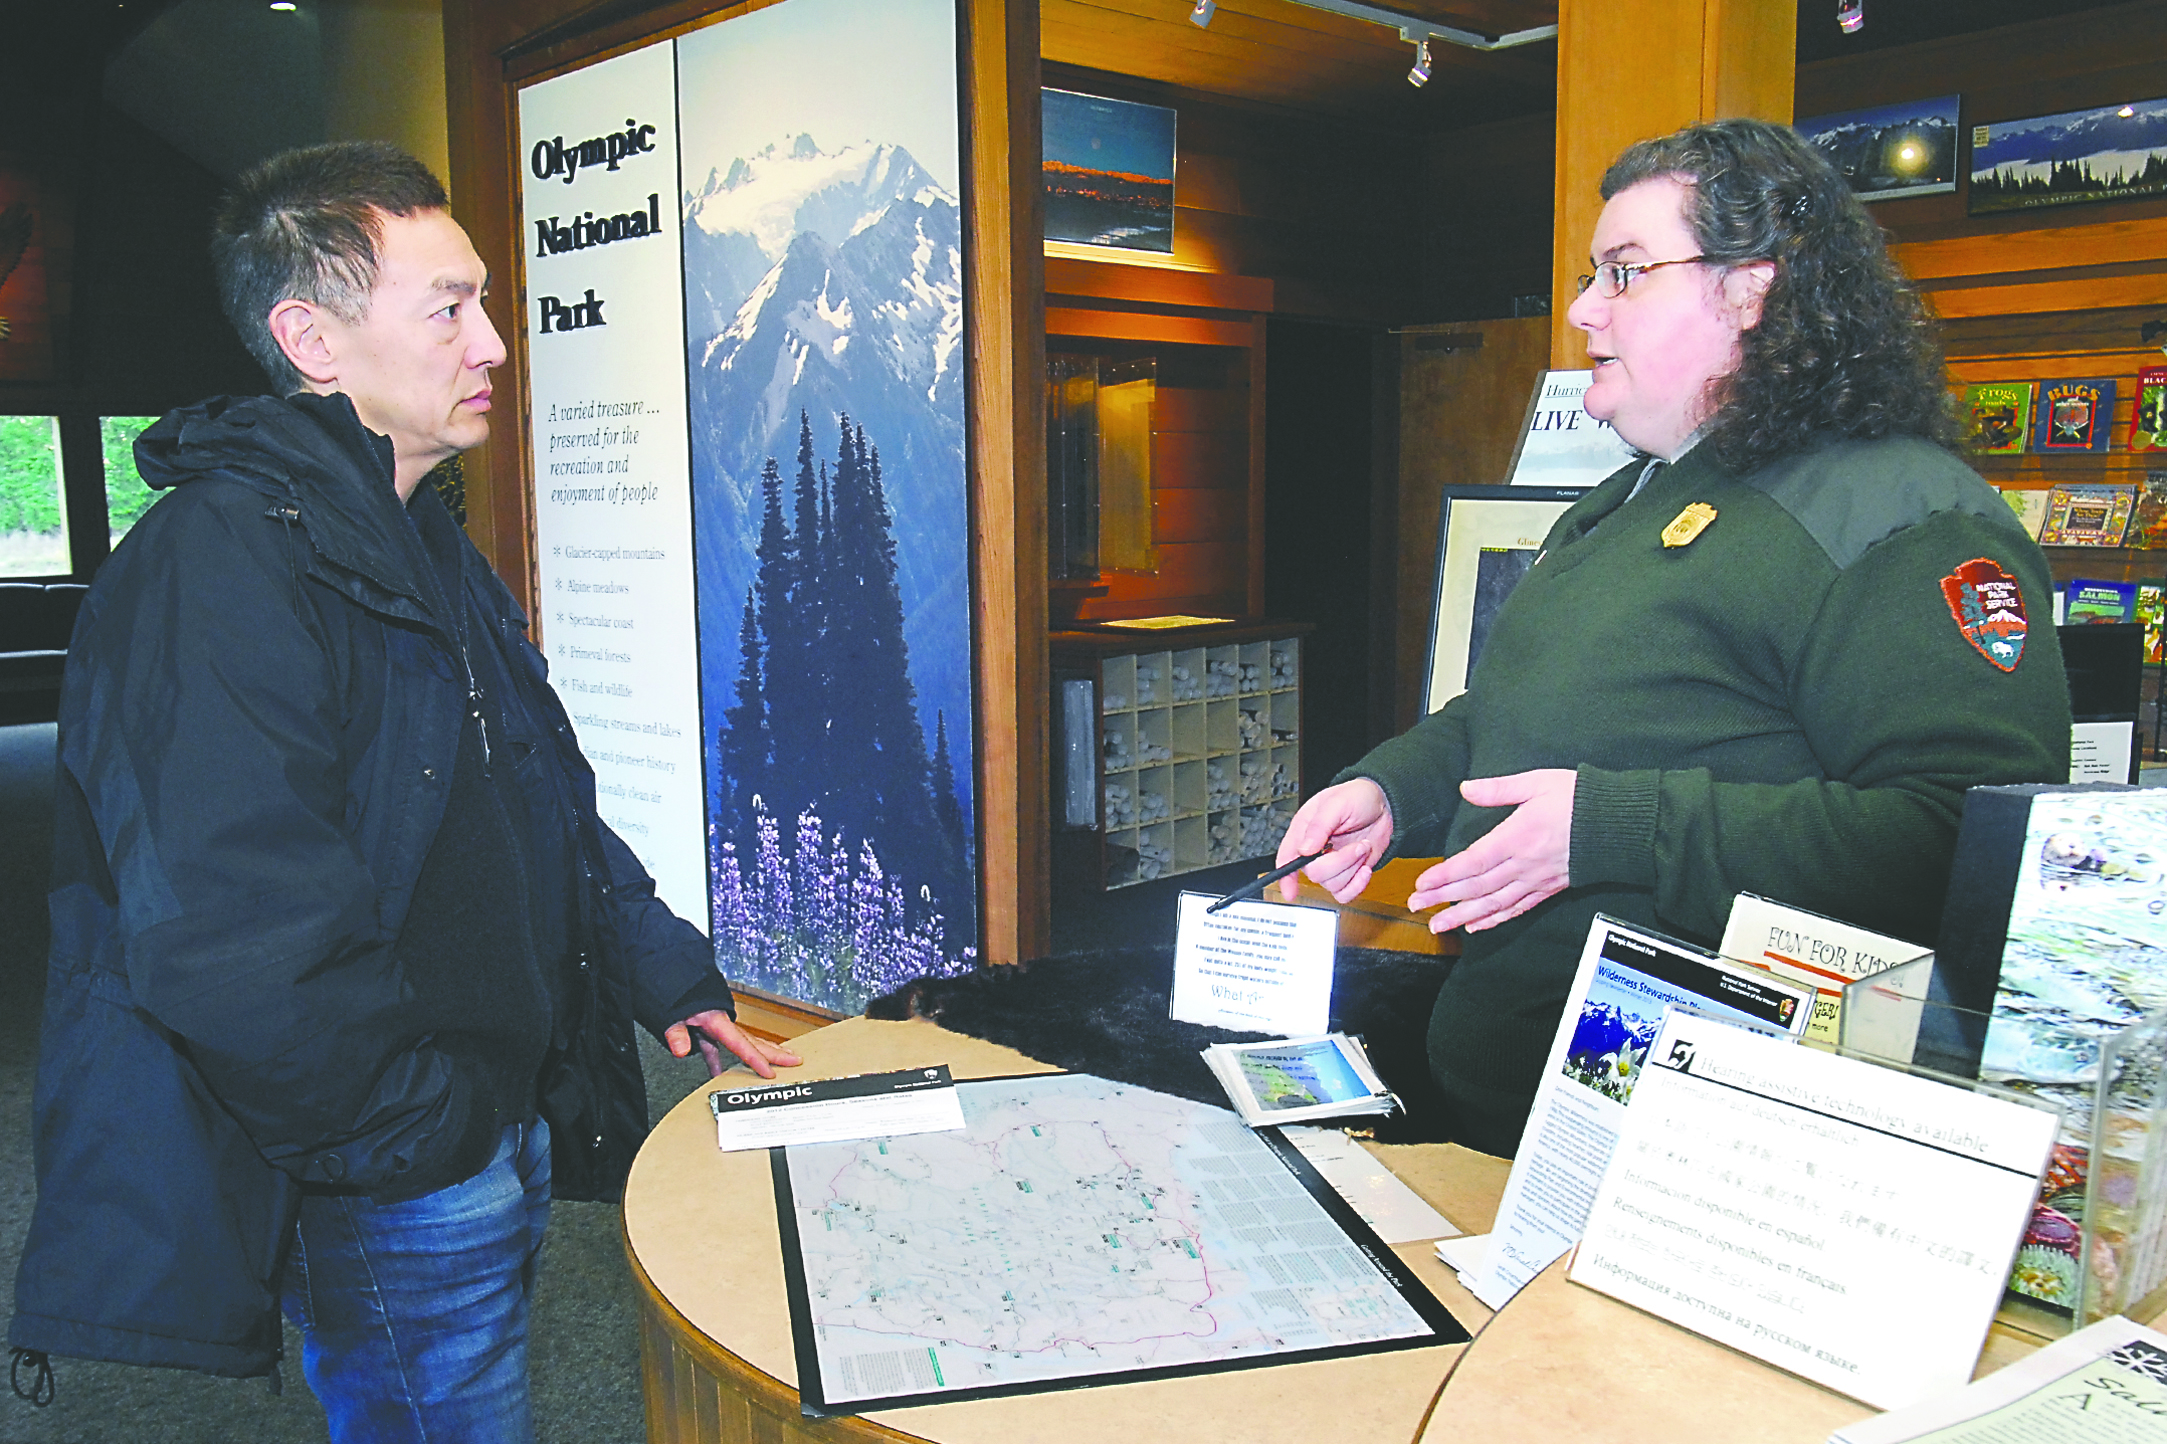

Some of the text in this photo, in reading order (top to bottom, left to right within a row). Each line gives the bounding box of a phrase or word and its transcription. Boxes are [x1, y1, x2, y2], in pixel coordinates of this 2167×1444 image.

[531, 118, 656, 185] Olympic
[2088, 186, 2153, 199] NATIONAL
[534, 193, 662, 258] National
[537, 289, 607, 334] Park
[2047, 384, 2101, 401] BUGS
[548, 404, 557, 422] A
[561, 400, 594, 421] varied
[598, 400, 644, 417] treasure
[1532, 410, 1583, 431] LIVE
[550, 425, 640, 452] preserved for the
[550, 454, 629, 476] recreation and
[551, 481, 658, 506] enjoyment of people
[622, 546, 666, 560] mountains
[567, 580, 629, 594] Alpine meadows
[1976, 582, 2016, 592] NATIONAL
[1987, 590, 2009, 599] PARK
[2079, 591, 2120, 601] SALMON
[1986, 598, 2018, 610] SERVICE
[569, 613, 634, 629] Spectacular coast
[604, 650, 631, 663] forests
[572, 678, 632, 698] Fish and wildlife
[610, 718, 641, 732] streams
[642, 723, 658, 735] and
[660, 724, 681, 738] lakes
[600, 750, 614, 762] and
[646, 755, 676, 774] history
[1768, 926, 1809, 954] FUN
[1810, 940, 1847, 973] FOR
[1598, 966, 1638, 990] Wilderness
[727, 1084, 812, 1105] Olympic
[1700, 1057, 1754, 1084] Hearing
[1758, 1081, 1816, 1103] assistive
[1824, 1095, 1904, 1129] technology
[1751, 1106, 1796, 1127] deutsch
[1694, 1197, 1754, 1225] disponible
[1757, 1221, 1771, 1231] en
[1613, 1196, 1701, 1237] Renseignements
[1705, 1235, 1772, 1264] disponibles
[1777, 1262, 1791, 1273] en
[1593, 1253, 1670, 1294] Информация
[1672, 1291, 1731, 1320] доступна
[1735, 1316, 1750, 1328] на
[1753, 1323, 1811, 1353] русском
